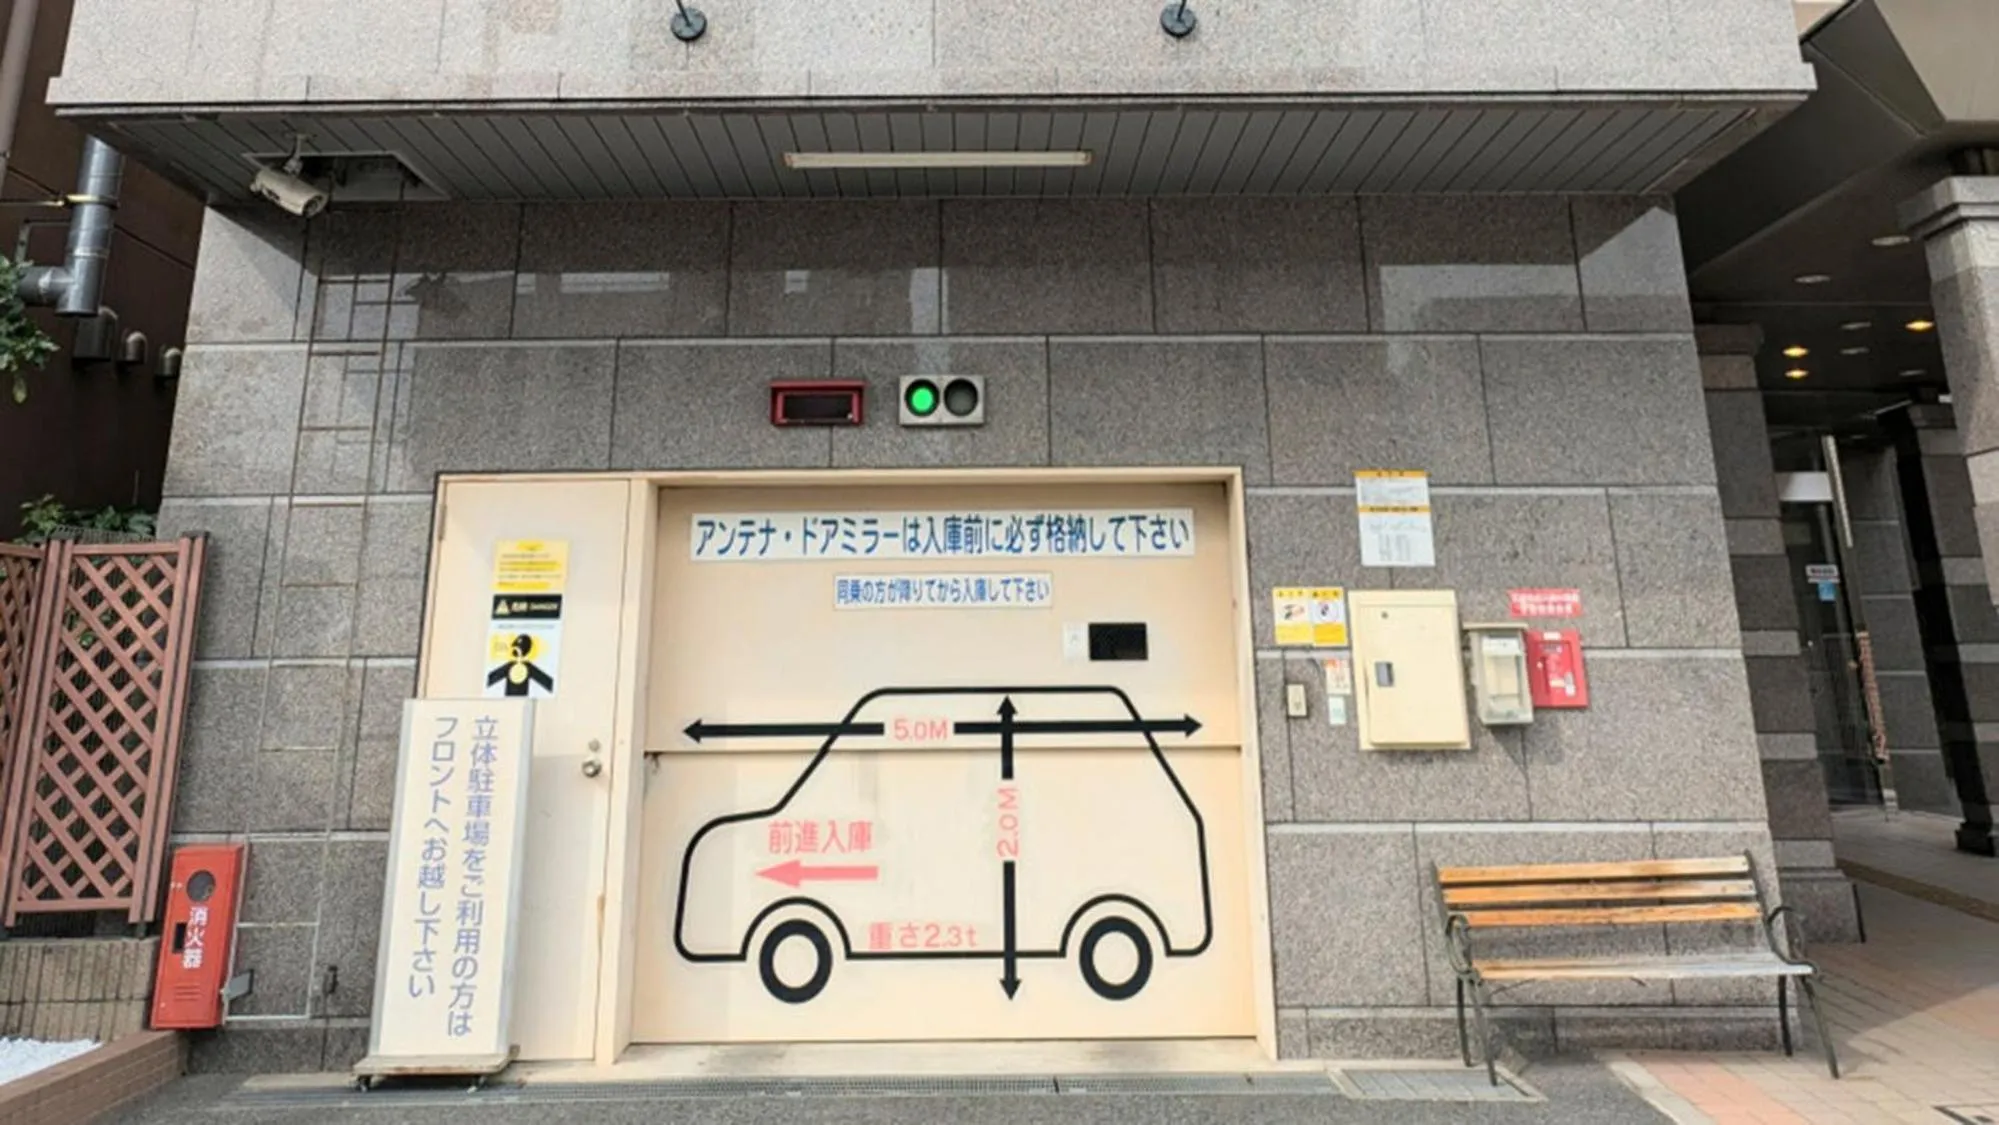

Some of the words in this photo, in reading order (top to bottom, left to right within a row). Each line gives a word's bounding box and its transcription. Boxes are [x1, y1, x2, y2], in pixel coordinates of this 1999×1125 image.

[696, 514, 1189, 555] アンテナ・ドアミラーは入庫前に必ず格納して下さい
[894, 720, 948, 740] 5.0M
[767, 820, 874, 854] 前進入庫
[996, 786, 1019, 857] 2.0M
[408, 716, 458, 998] フロントへお越し下さい
[447, 716, 500, 1036] 立体駐車場をご利用の方は
[183, 907, 208, 968] 消火器
[868, 922, 977, 950] 重さ2.3t
